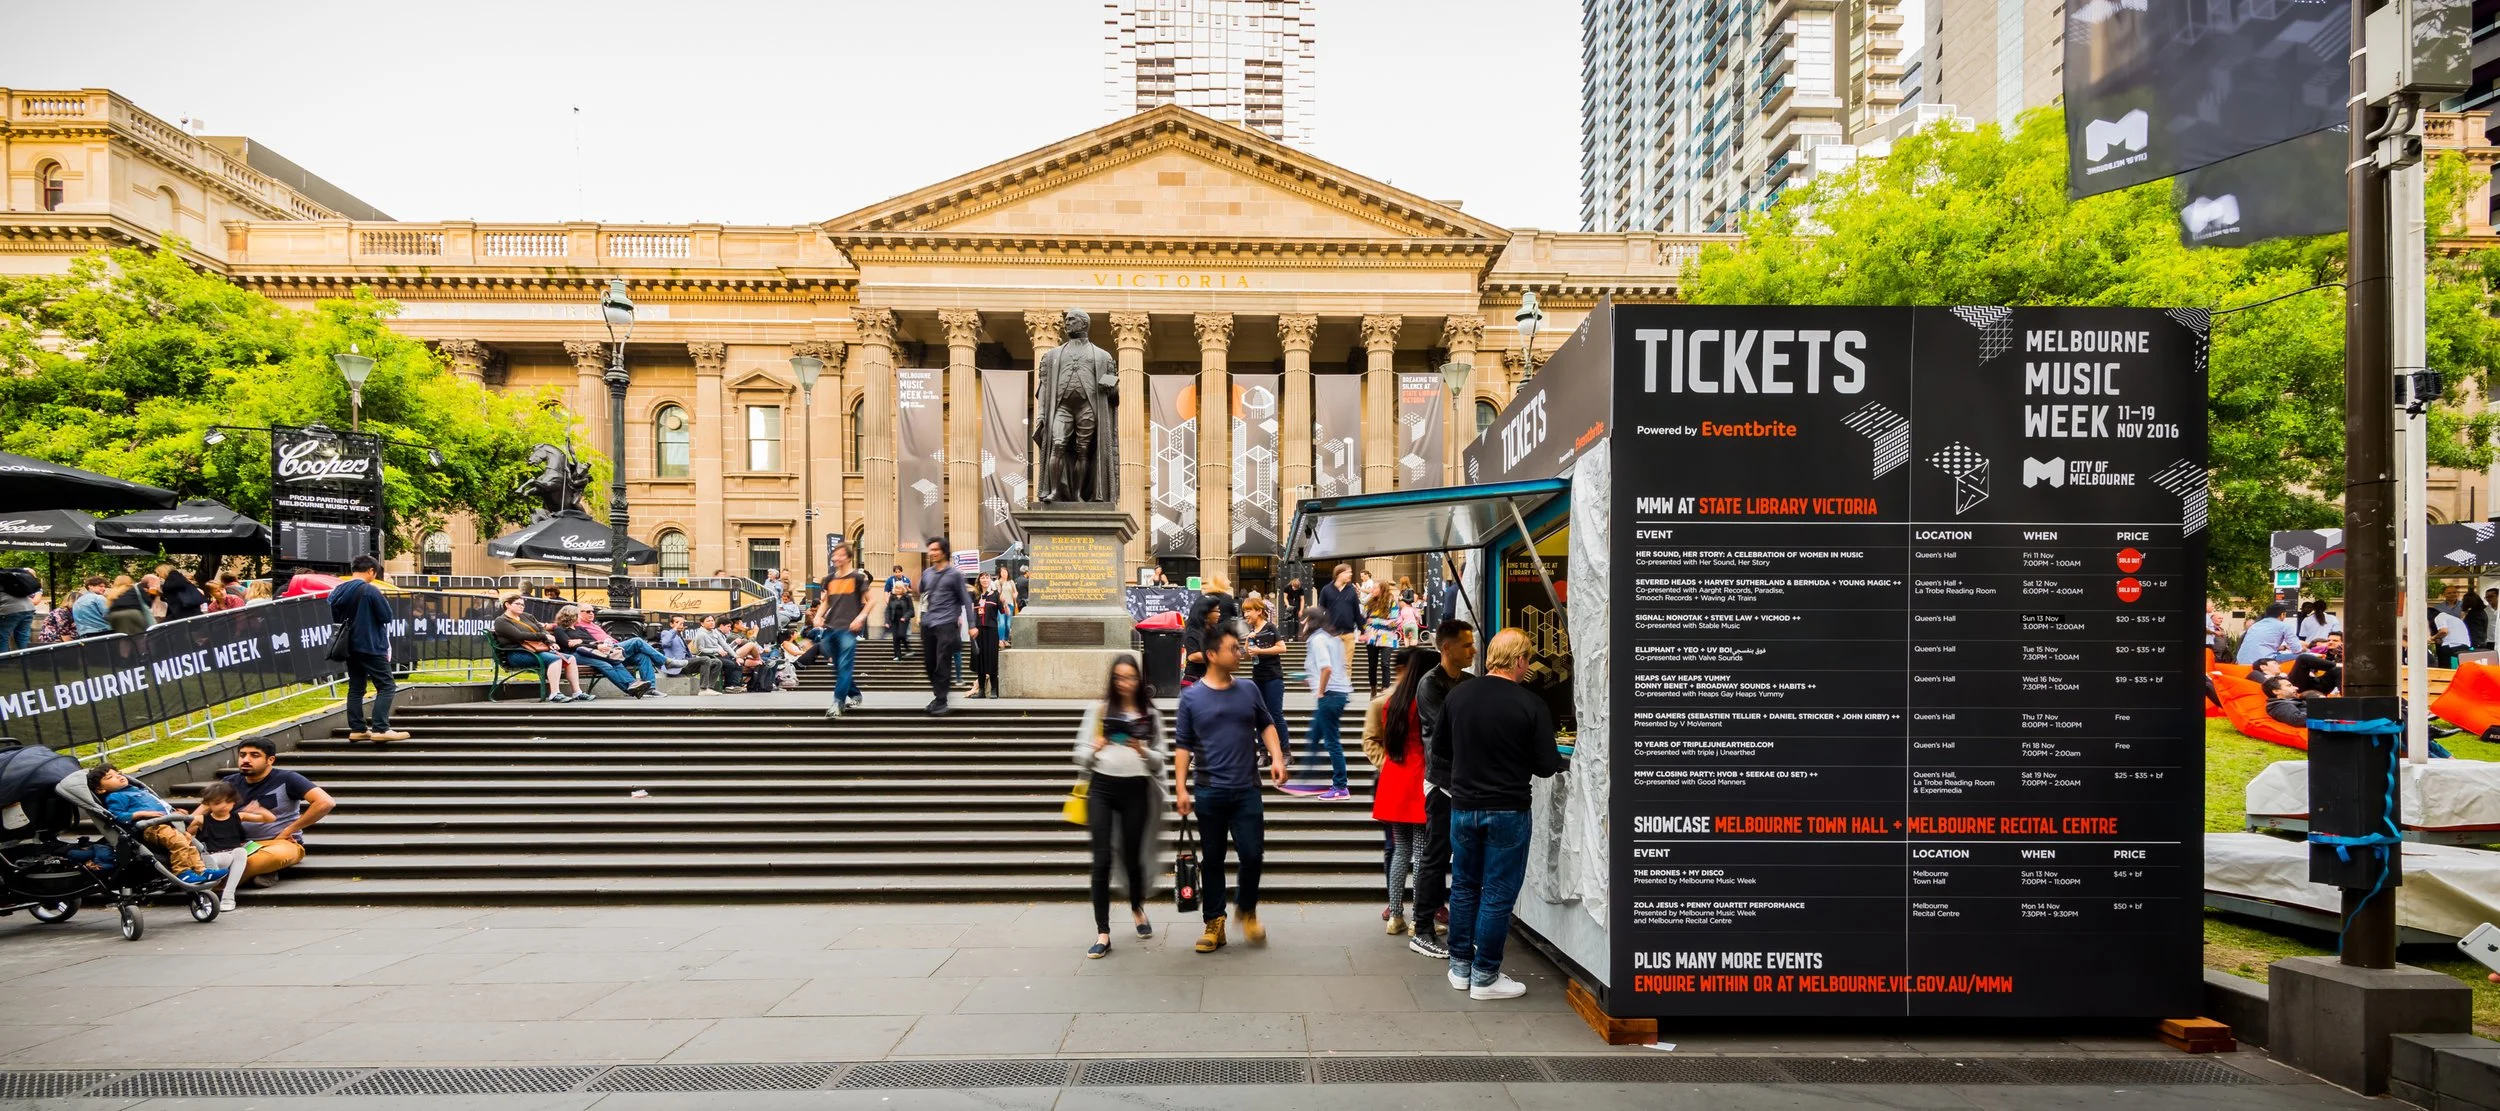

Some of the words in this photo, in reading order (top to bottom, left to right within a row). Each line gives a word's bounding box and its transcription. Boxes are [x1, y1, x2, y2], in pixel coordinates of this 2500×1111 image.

[1093, 274, 1249, 288] VICTORIA
[2026, 330, 2150, 353] MELBOURNE
[1635, 328, 1867, 394] TICKETS
[900, 380, 924, 389] MUSIC
[2025, 362, 2121, 395] MUSIC
[900, 391, 921, 399] WEEK
[2025, 404, 2110, 438] WEEK
[1501, 389, 1547, 474] TICKETS
[1637, 425, 1682, 435] Powered
[1684, 425, 1698, 437] by
[1702, 421, 1797, 437] Eventbrite
[2117, 423, 2143, 438] NOV
[2147, 423, 2179, 438] 2016
[1575, 420, 1605, 452] Eventbrite
[279, 440, 369, 482] Coopers
[2070, 460, 2093, 473] CITY
[2095, 461, 2109, 473] OF
[2069, 473, 2135, 486] MELBOURNE
[279, 500, 324, 509] MELBOURNE
[316, 496, 349, 504] PARTNER
[1636, 497, 1674, 514] MMW
[1677, 497, 1695, 514] AT
[1699, 497, 1742, 515] STATE
[1746, 497, 1809, 515] LIBRARY
[1812, 498, 1878, 515] VICTORIA
[1636, 530, 1673, 539] EVENT
[1915, 531, 1972, 540] LOCATION
[2023, 531, 2058, 540] WHEN
[2117, 532, 2149, 541] PRICE
[561, 535, 605, 550] Coopers
[1652, 550, 1681, 558] SOUND,
[1945, 587, 1974, 595] Reading
[669, 592, 702, 610] Coopers
[1635, 621, 1681, 630] Co-presented
[0, 666, 149, 720] MELBOURNE
[152, 649, 211, 685] MUSIC
[213, 638, 262, 668] WEEK
[1634, 816, 1710, 833] SHOWCASE
[1715, 816, 1802, 833] MELBOURNE
[1807, 816, 1847, 833] TOWN
[1851, 817, 1888, 833] HALL
[1907, 816, 1996, 834] MELBOURNE
[2000, 817, 2058, 834] RECITAL
[2062, 817, 2117, 834] CENTRE
[1634, 848, 1671, 858] EVENT
[1913, 849, 1970, 858] LOCATION
[2021, 849, 2055, 859] WHEN
[2114, 850, 2146, 859] PRICE
[1634, 952, 1671, 969] PLUS
[1675, 952, 1717, 969] MANY
[1721, 952, 1762, 969] MORE
[1767, 952, 1823, 969] EVENTS
[1634, 975, 1696, 994] ENQUIRE
[1700, 975, 1749, 992] WITHIN
[1753, 975, 1773, 992] OR
[1777, 975, 1794, 992] AT
[1799, 974, 2013, 996] MELBOURNE.VIC.GOV.AU/MMW
